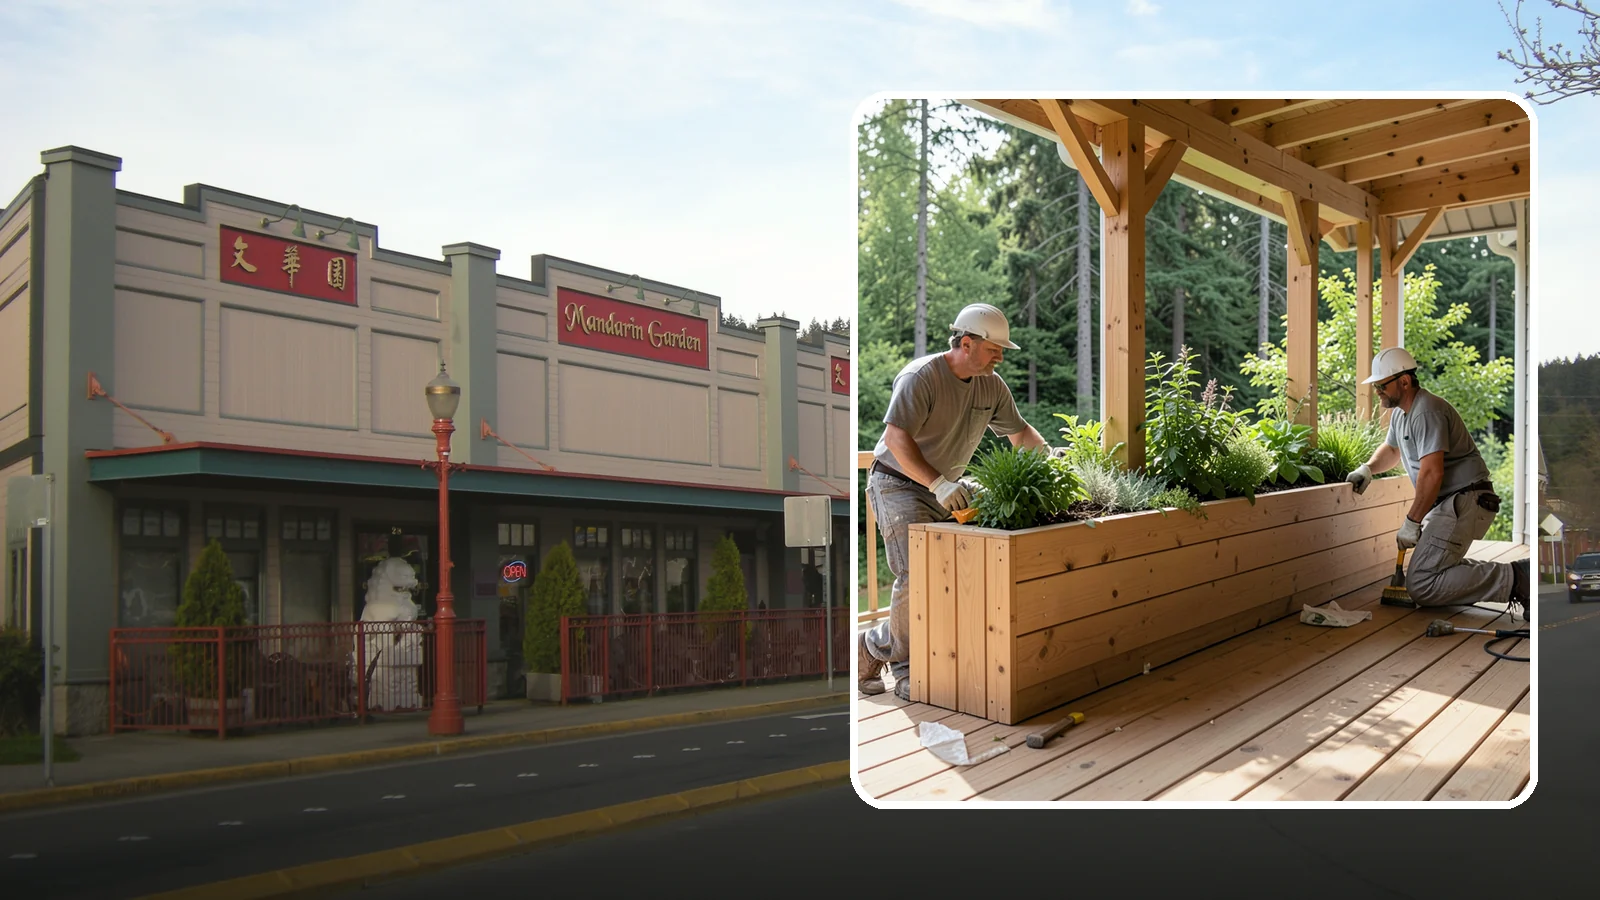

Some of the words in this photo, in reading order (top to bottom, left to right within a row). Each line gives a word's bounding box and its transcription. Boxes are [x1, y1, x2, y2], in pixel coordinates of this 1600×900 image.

[231, 235, 346, 291] 文華園
[564, 302, 644, 340] Mandarin
[648, 320, 702, 352] Garden
[503, 565, 527, 578] OPEN
